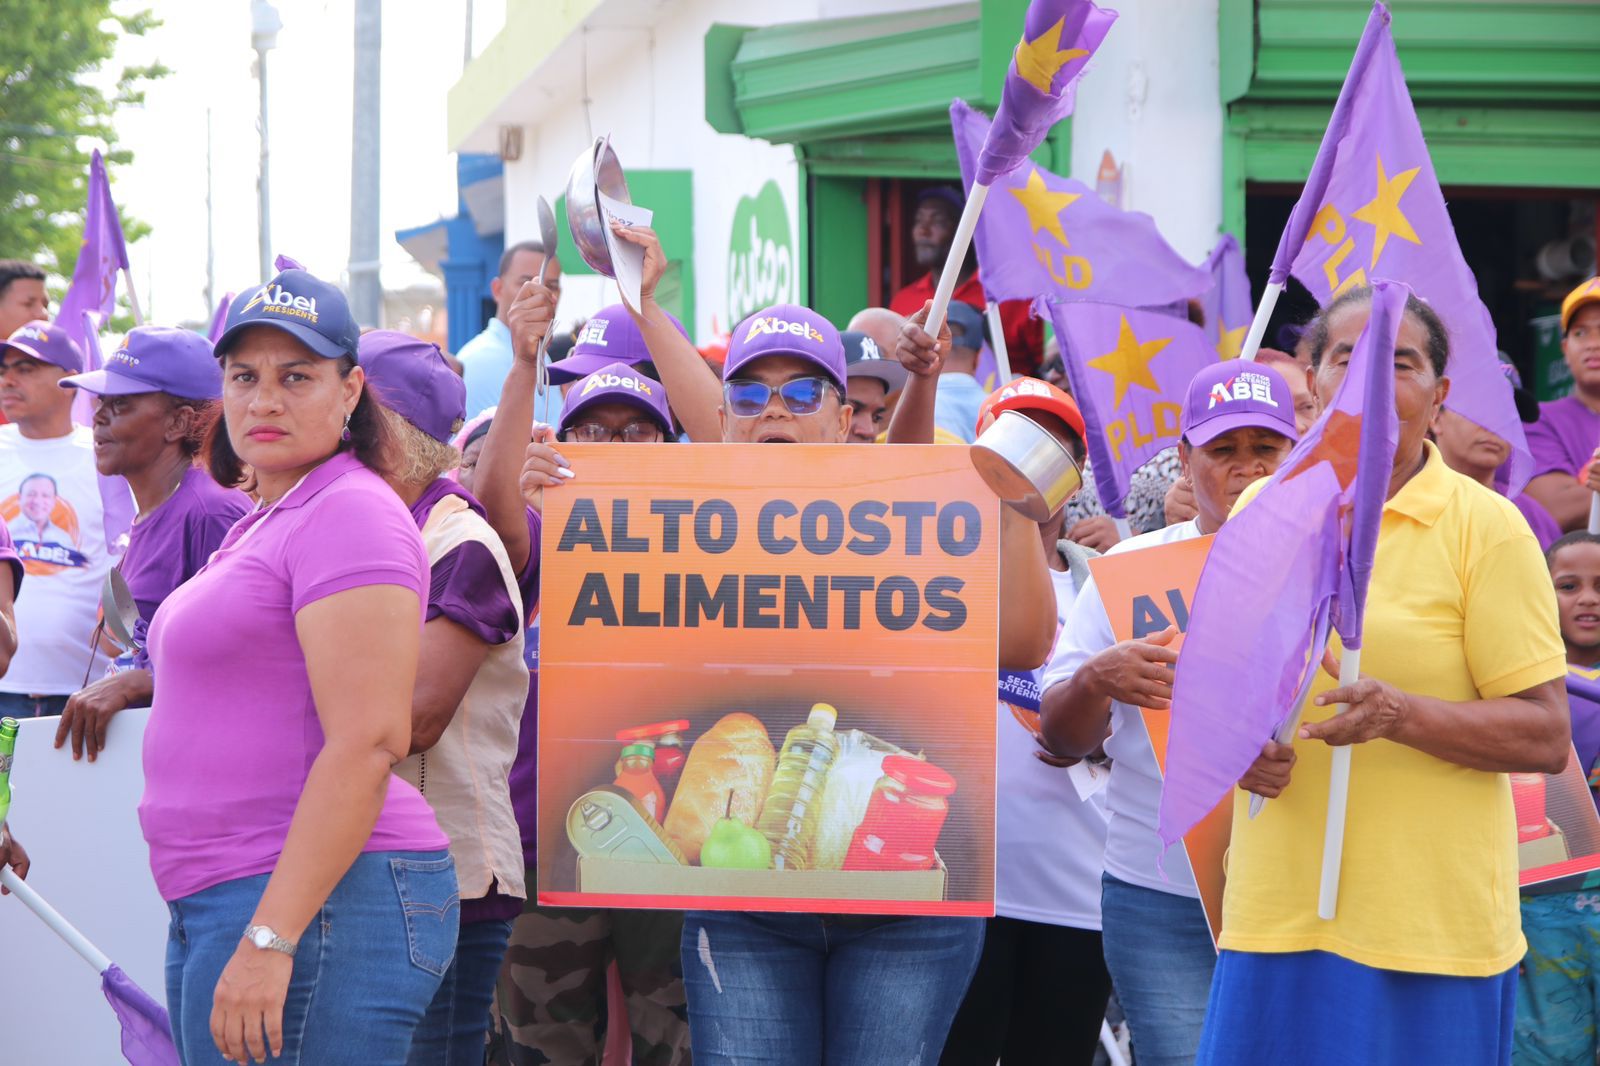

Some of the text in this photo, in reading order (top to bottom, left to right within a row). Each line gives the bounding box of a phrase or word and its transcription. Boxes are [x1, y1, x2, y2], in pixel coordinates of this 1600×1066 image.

[240, 283, 318, 315] Abel
[263, 305, 318, 324] PRESIDENTE
[1208, 381, 1279, 410] ABEL
[1106, 402, 1181, 462] PLD
[556, 498, 982, 557] ALTO COSTO
[567, 572, 968, 632] ALIMENTOS
[1007, 675, 1040, 692] SECTO
